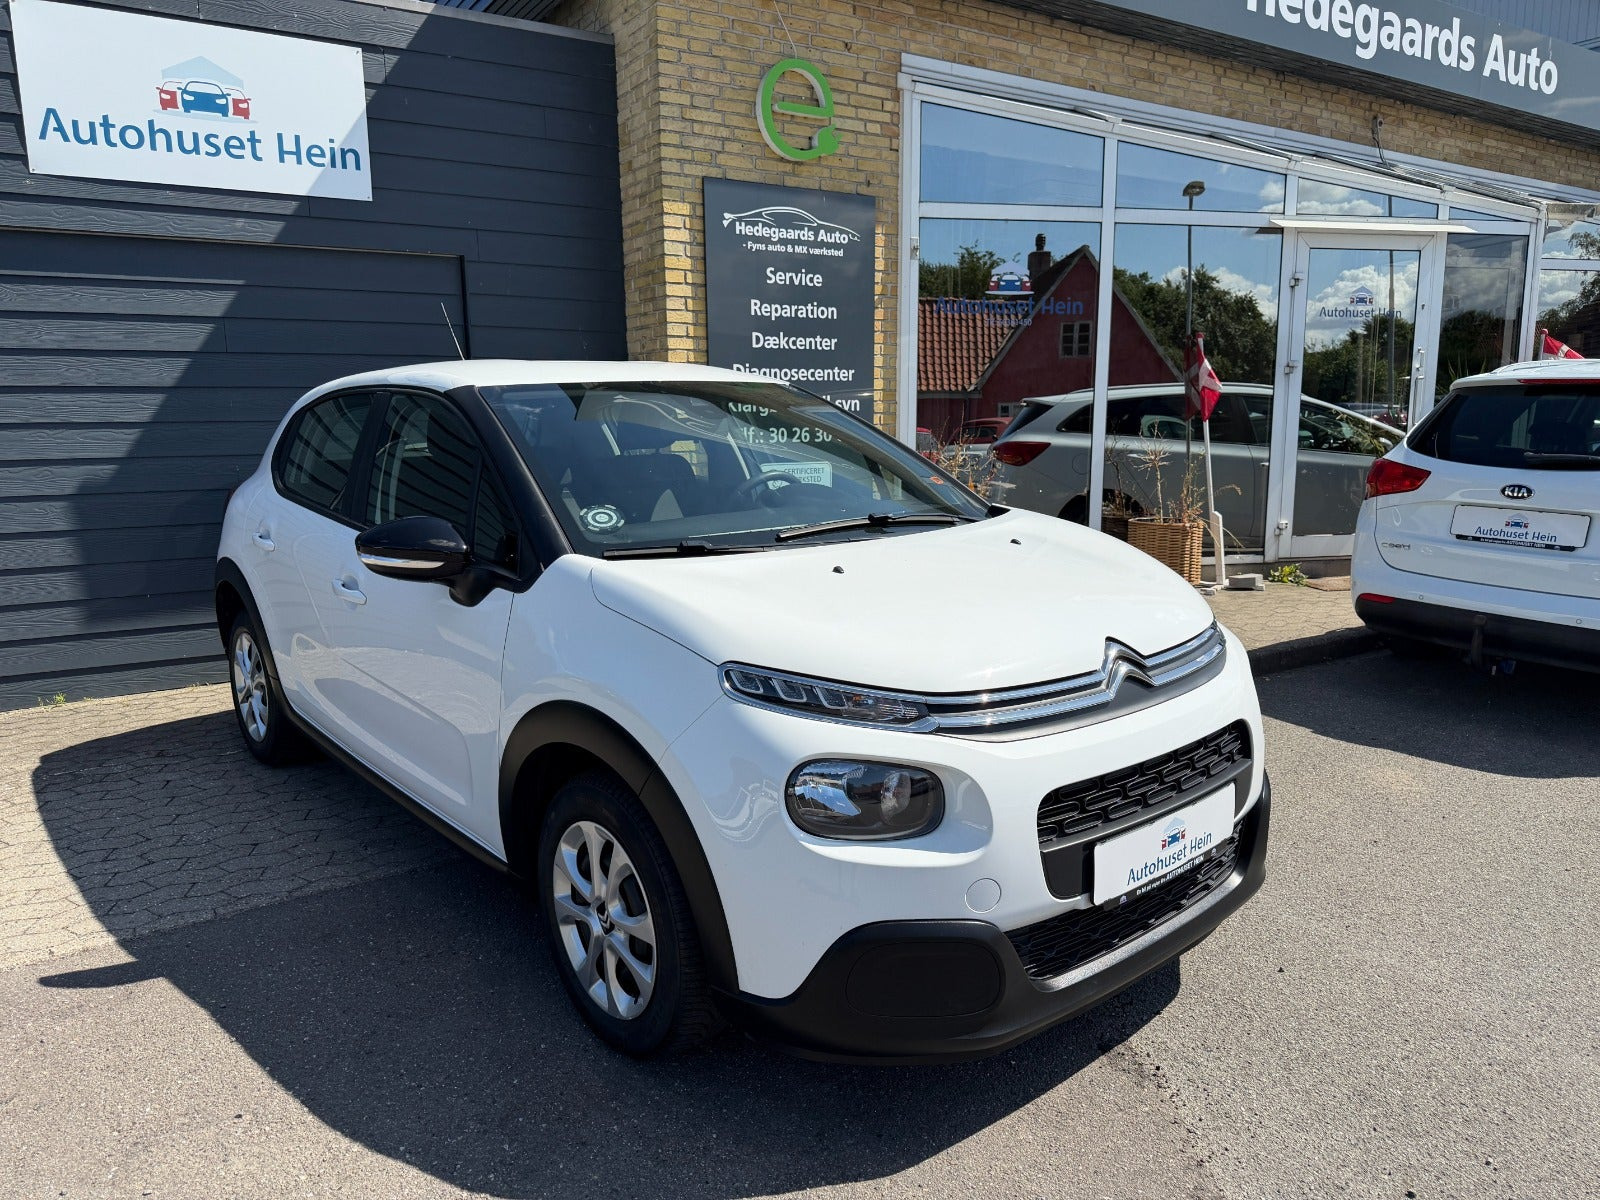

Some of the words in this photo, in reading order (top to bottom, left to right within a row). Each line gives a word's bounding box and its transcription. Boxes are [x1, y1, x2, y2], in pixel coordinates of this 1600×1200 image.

[1247, 0, 1476, 60] edegaards
[1483, 33, 1558, 95] Auto
[38, 107, 263, 162] Autohuset
[277, 132, 361, 171] Hein
[735, 221, 815, 242] Hedegaards
[817, 229, 849, 244] Auto
[747, 241, 766, 252] Fyns
[767, 244, 786, 252] auto
[787, 244, 793, 253] &
[794, 245, 808, 254] MX
[809, 246, 844, 257] værksted
[766, 267, 823, 287] Service
[750, 299, 837, 320] Reparation
[935, 297, 1034, 315] Autohuset
[1041, 297, 1084, 315] Hein
[1319, 306, 1376, 318] Autohuset
[751, 331, 837, 351] Dækcenter
[769, 427, 787, 443] 30
[792, 427, 811, 443] 26
[1504, 486, 1528, 497] KIA
[1475, 526, 1529, 540] Autohuset
[1532, 531, 1557, 542] Hein
[1126, 843, 1187, 886] Autohuset
[1189, 832, 1213, 855] Hein
